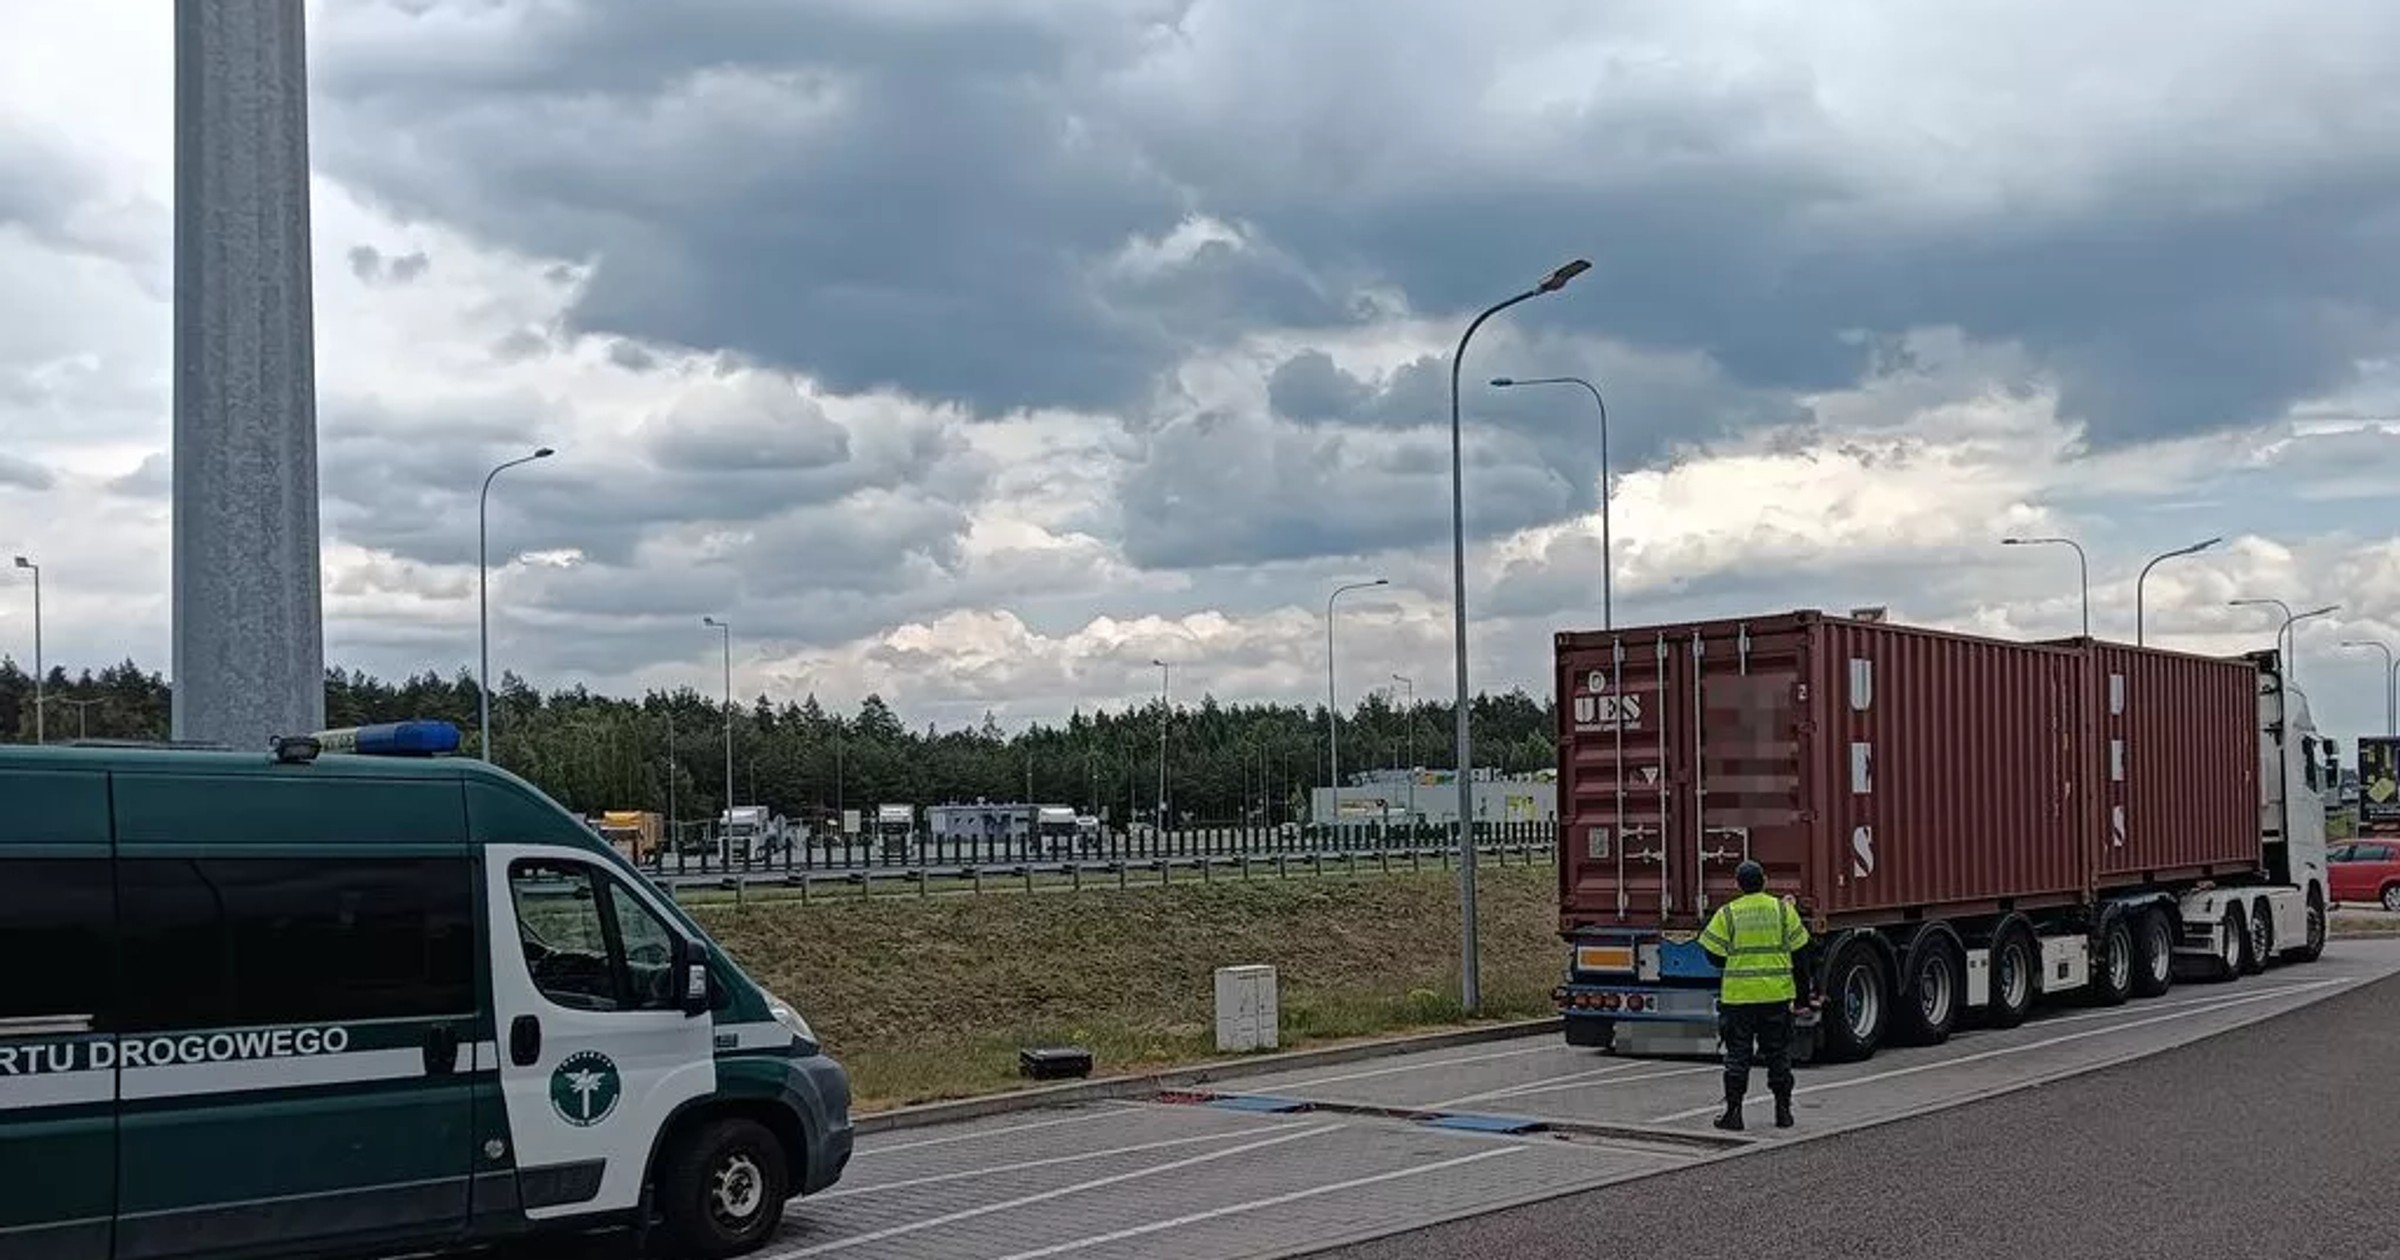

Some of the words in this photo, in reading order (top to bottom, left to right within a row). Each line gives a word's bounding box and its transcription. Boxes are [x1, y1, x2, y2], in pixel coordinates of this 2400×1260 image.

[1574, 693, 1642, 723] UES
[0, 1043, 74, 1075] RTU
[88, 1025, 349, 1070] DROGOWEGO
